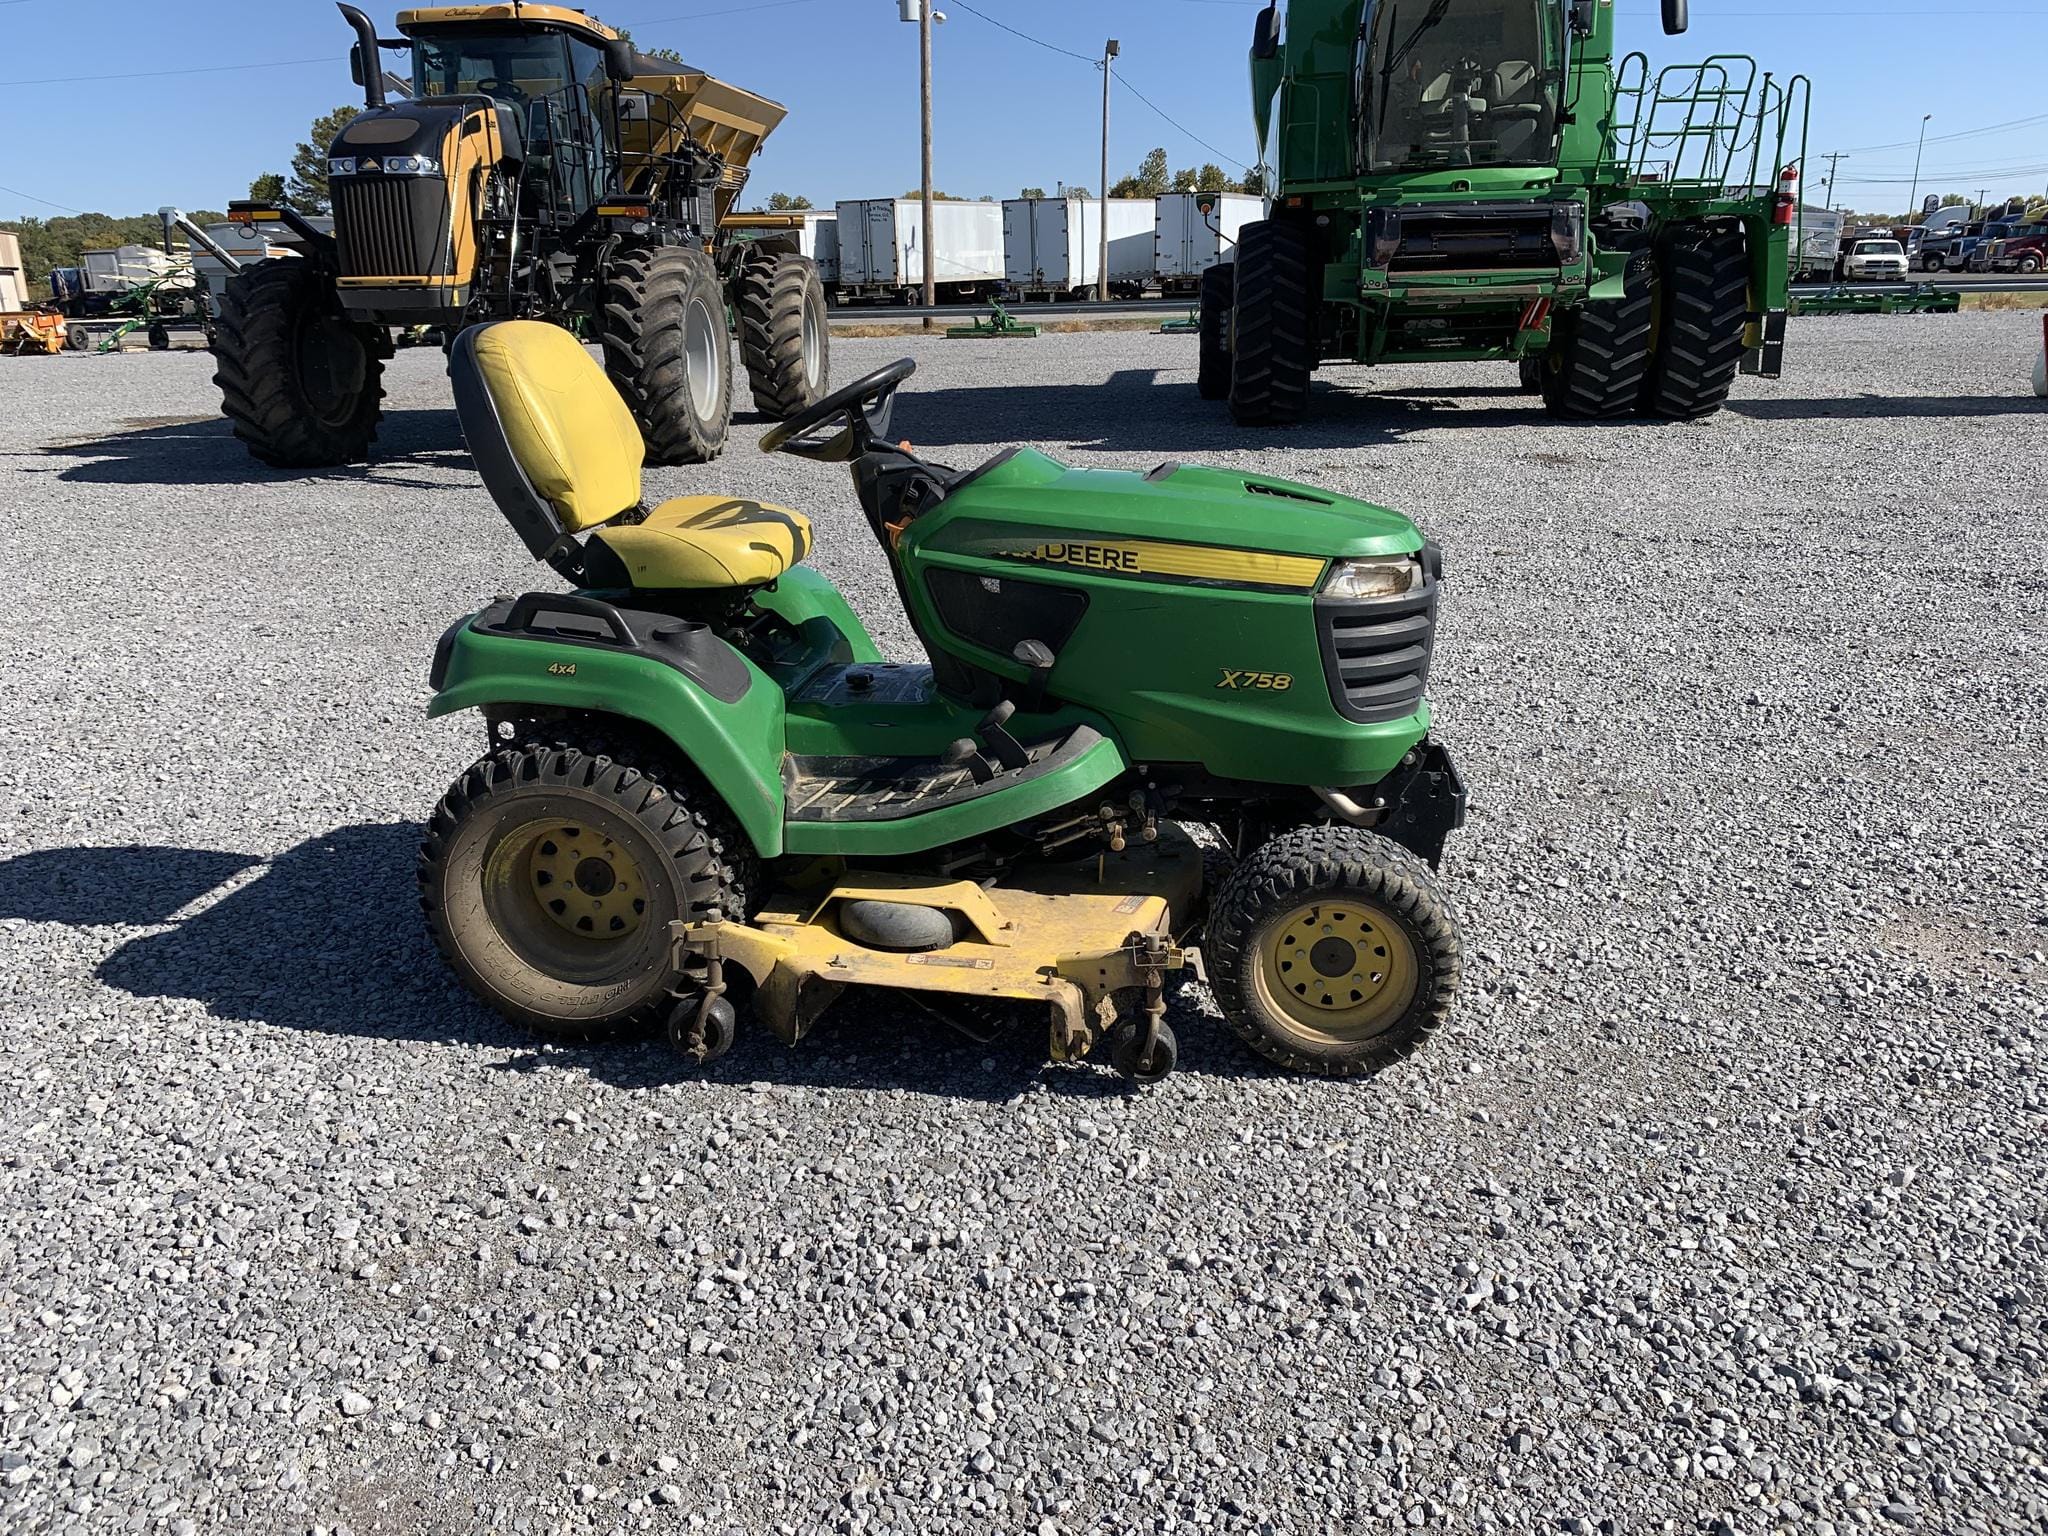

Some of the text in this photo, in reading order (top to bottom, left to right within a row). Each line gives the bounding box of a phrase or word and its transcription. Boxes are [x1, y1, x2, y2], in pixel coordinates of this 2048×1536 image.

[1044, 543, 1140, 572] DEERE
[547, 662, 576, 675] 4x4
[1216, 669, 1292, 690] X758
[483, 956, 536, 996] TRAX
[540, 993, 600, 1006] FIELD
